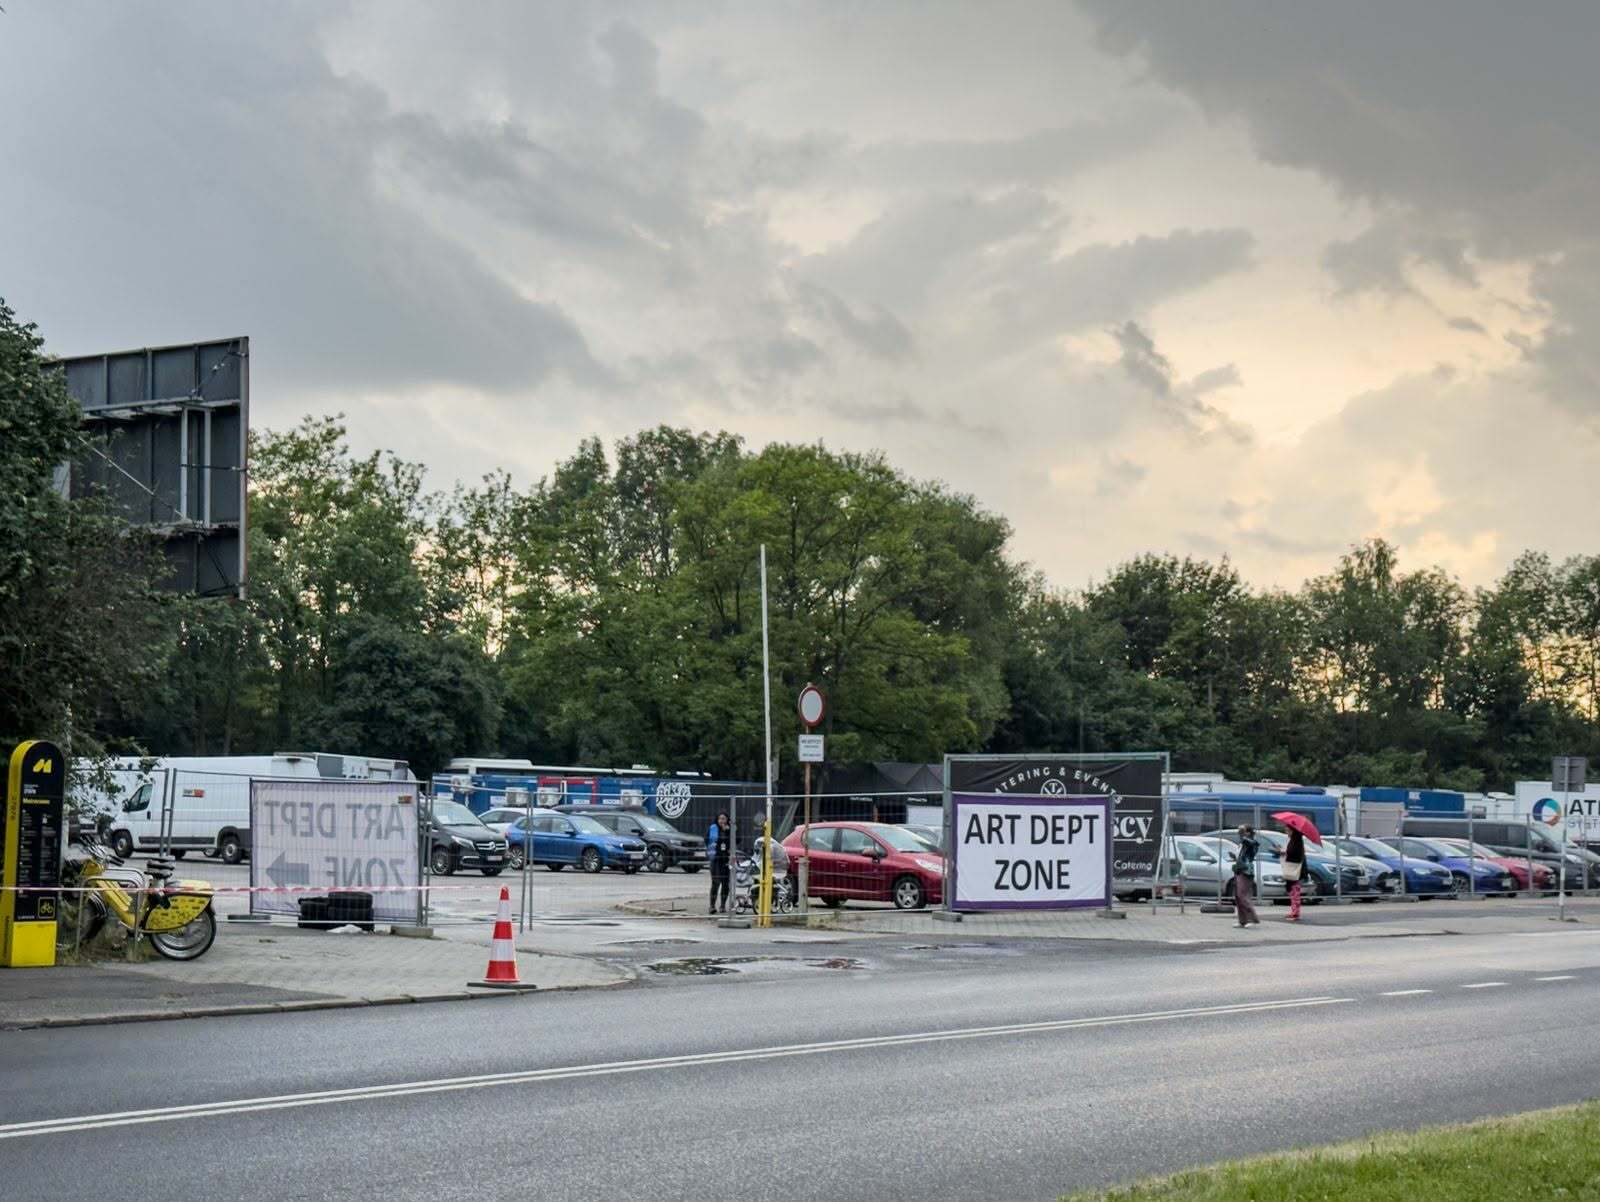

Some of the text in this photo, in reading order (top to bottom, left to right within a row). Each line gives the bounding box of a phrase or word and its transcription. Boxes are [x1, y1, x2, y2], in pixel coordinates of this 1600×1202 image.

[1059, 766, 1066, 777] &
[1073, 770, 1123, 804] EVENTS
[1569, 799, 1600, 815] AT
[964, 813, 1099, 845] ART DEPT
[994, 859, 1071, 891] ZONE
[1114, 860, 1153, 871] Catering
